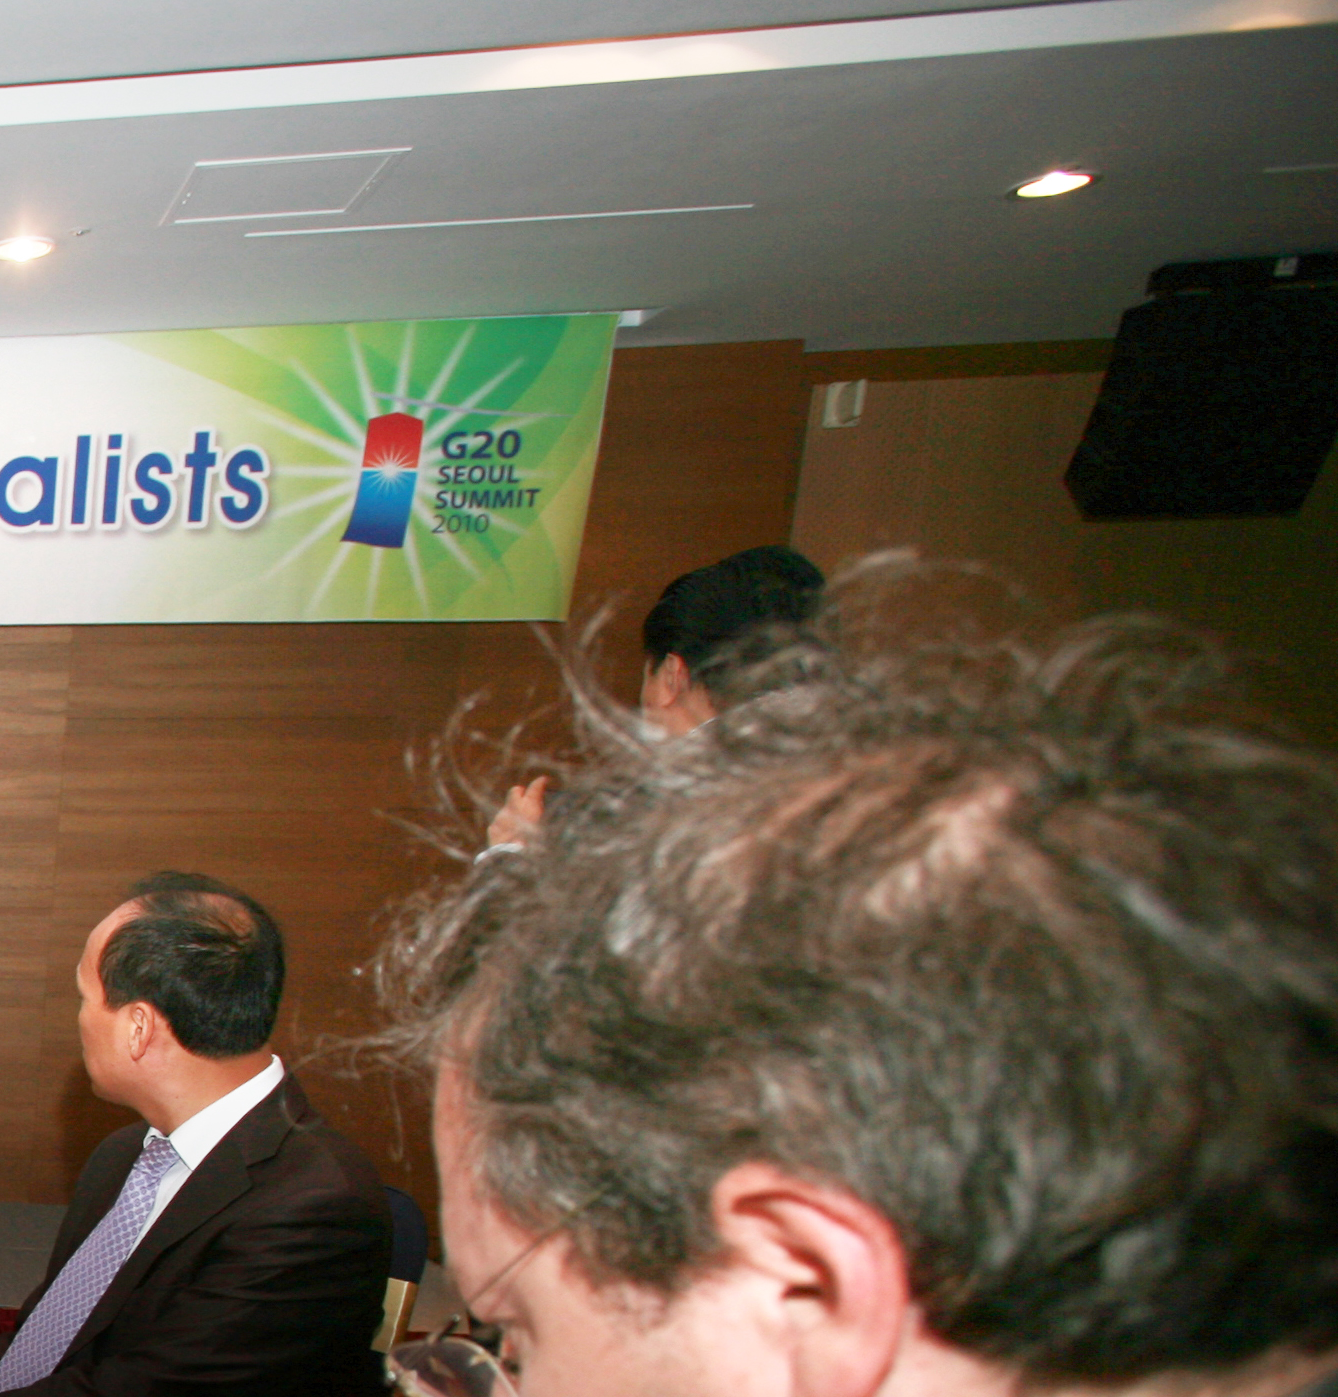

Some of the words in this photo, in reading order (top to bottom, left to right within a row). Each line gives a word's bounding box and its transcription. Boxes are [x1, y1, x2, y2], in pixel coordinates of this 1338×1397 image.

[441, 429, 522, 460] G20
[437, 464, 521, 485] SEOUL
[434, 488, 542, 509] SUMMIT
[431, 513, 491, 534] 2010
